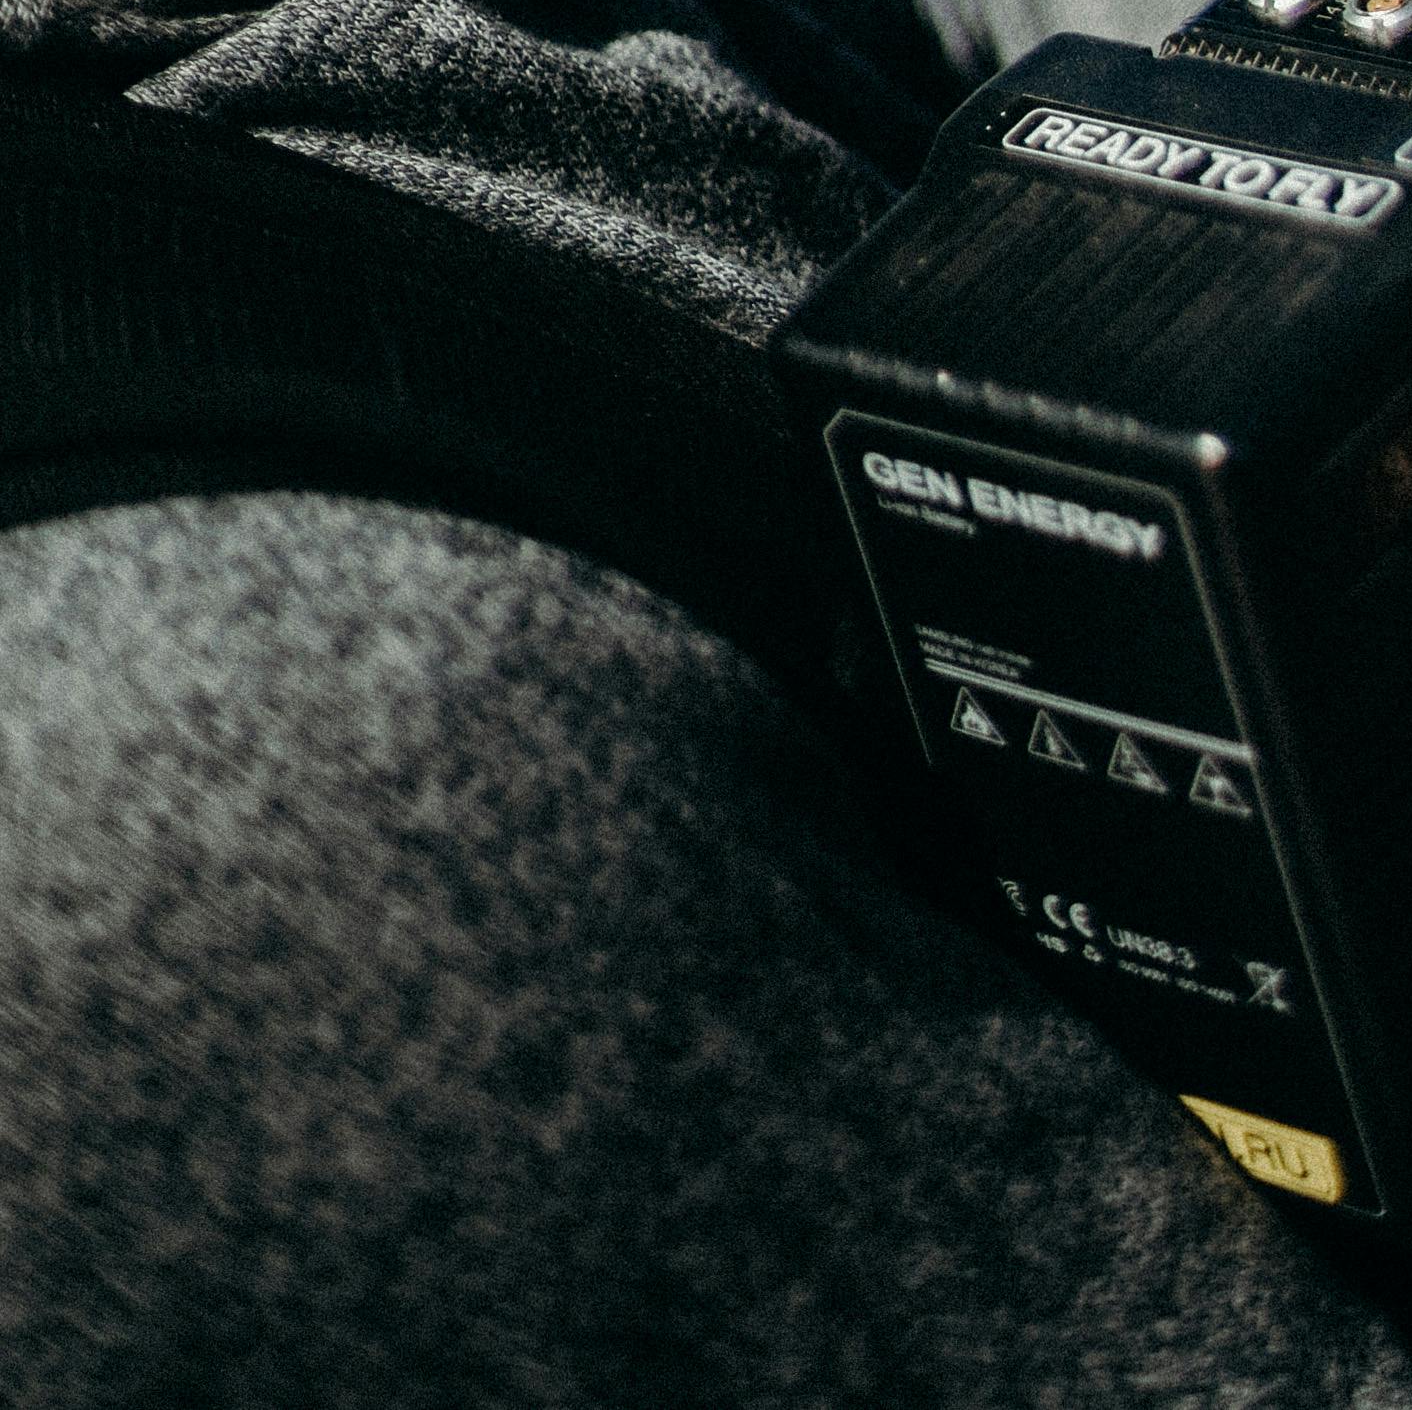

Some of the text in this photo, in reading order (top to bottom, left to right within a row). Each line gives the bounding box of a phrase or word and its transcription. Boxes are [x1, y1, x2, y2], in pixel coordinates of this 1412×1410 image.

[1024, 114, 1382, 218] READY TO FLY
[863, 451, 964, 508] GEN
[967, 477, 1163, 559] ENERGY
